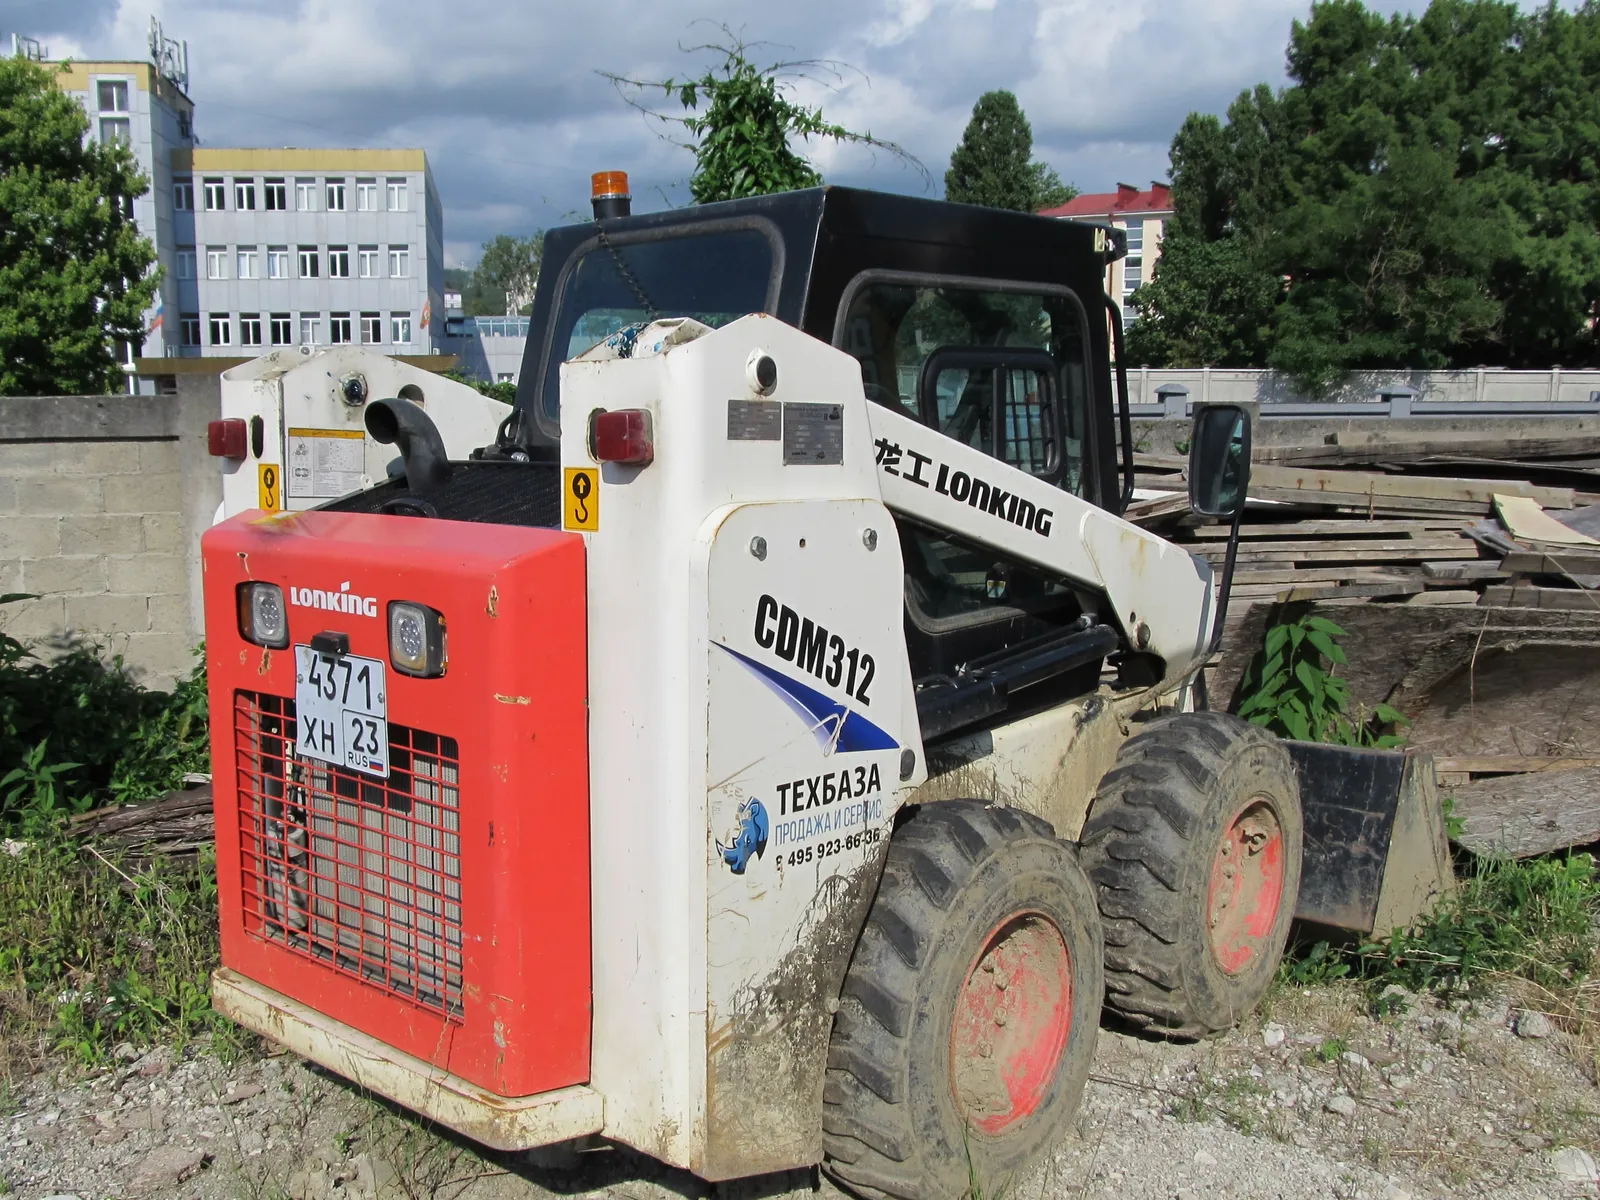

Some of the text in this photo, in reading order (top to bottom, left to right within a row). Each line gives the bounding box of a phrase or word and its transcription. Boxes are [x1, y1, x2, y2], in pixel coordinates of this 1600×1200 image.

[935, 463, 1054, 538] LONKING
[754, 594, 876, 707] CDM312
[309, 654, 372, 710] 4371
[351, 718, 379, 754] 23
[348, 751, 369, 768] RUS
[776, 763, 881, 816] ТЕХБАЗА
[775, 812, 832, 846] ПРОДАЖА
[834, 809, 842, 830] И
[788, 846, 813, 867] 495
